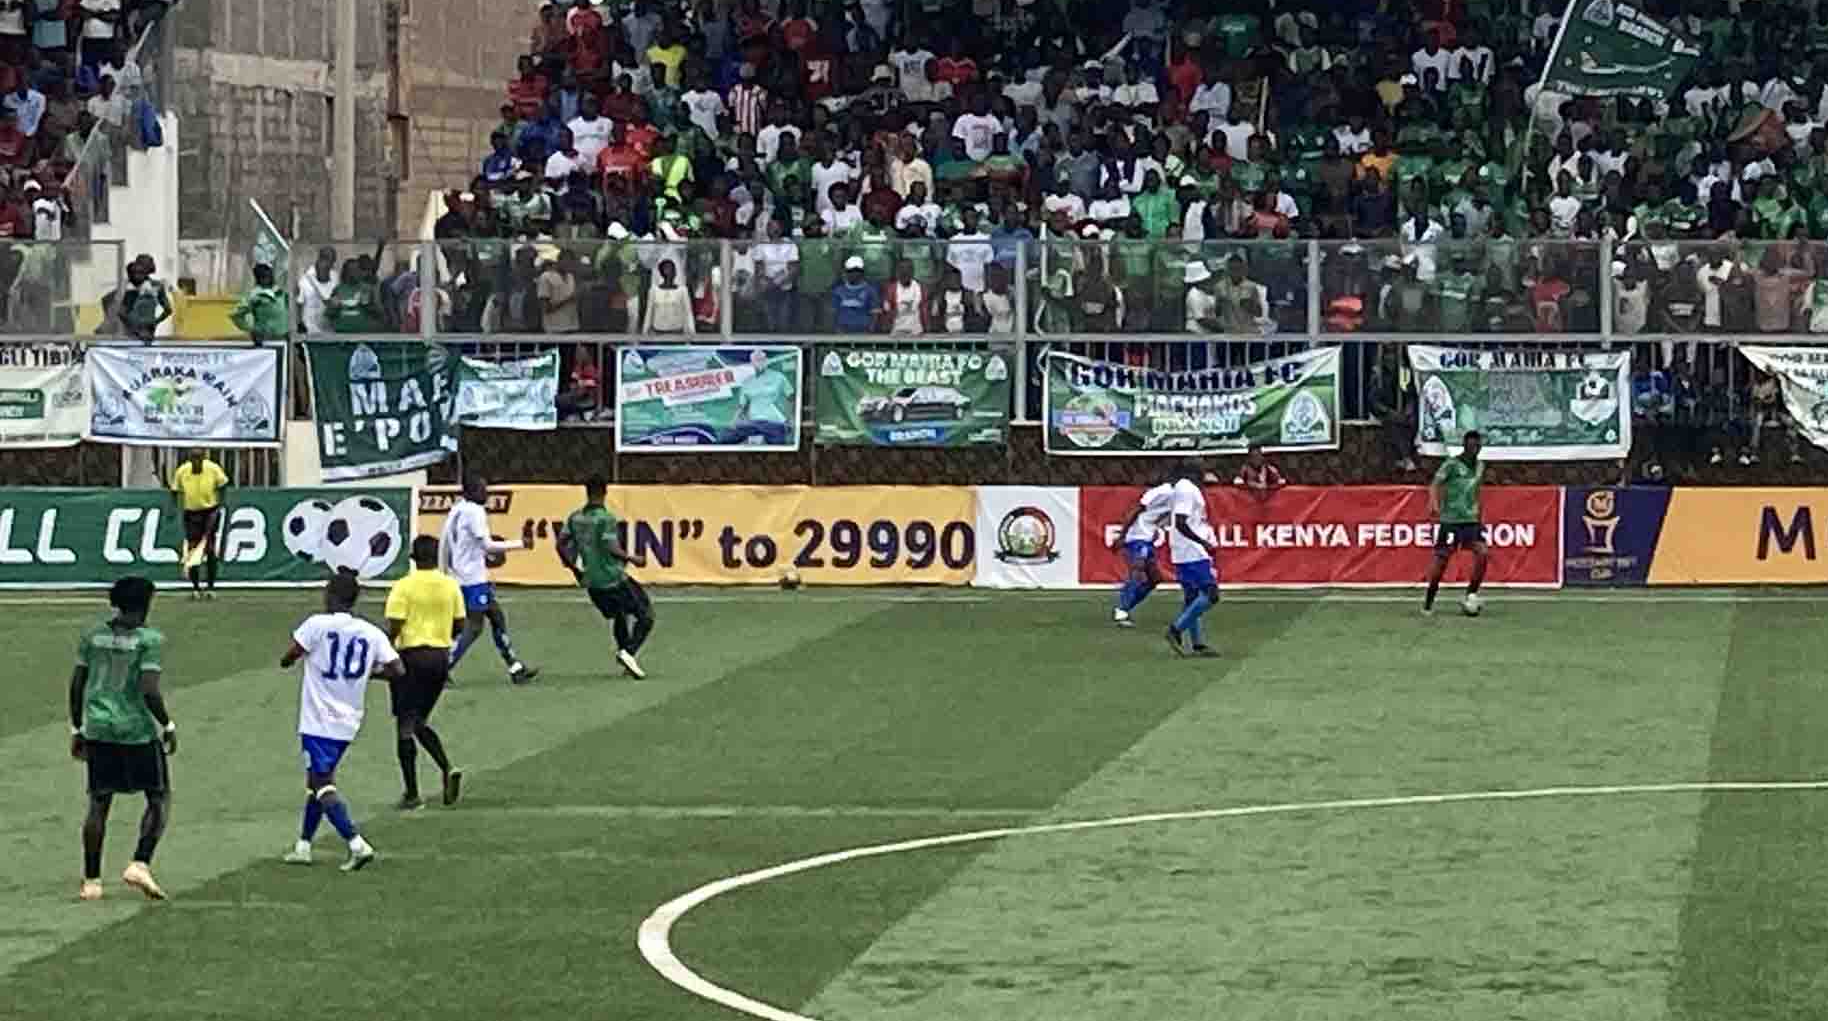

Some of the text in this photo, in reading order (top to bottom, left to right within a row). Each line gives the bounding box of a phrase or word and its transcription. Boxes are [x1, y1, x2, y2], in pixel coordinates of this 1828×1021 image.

[865, 369, 900, 384] THE
[102, 507, 269, 564] CLB
[718, 525, 778, 569] to
[792, 518, 976, 570] 29990
[1256, 524, 1350, 548] KENYA
[322, 630, 369, 681] 10
